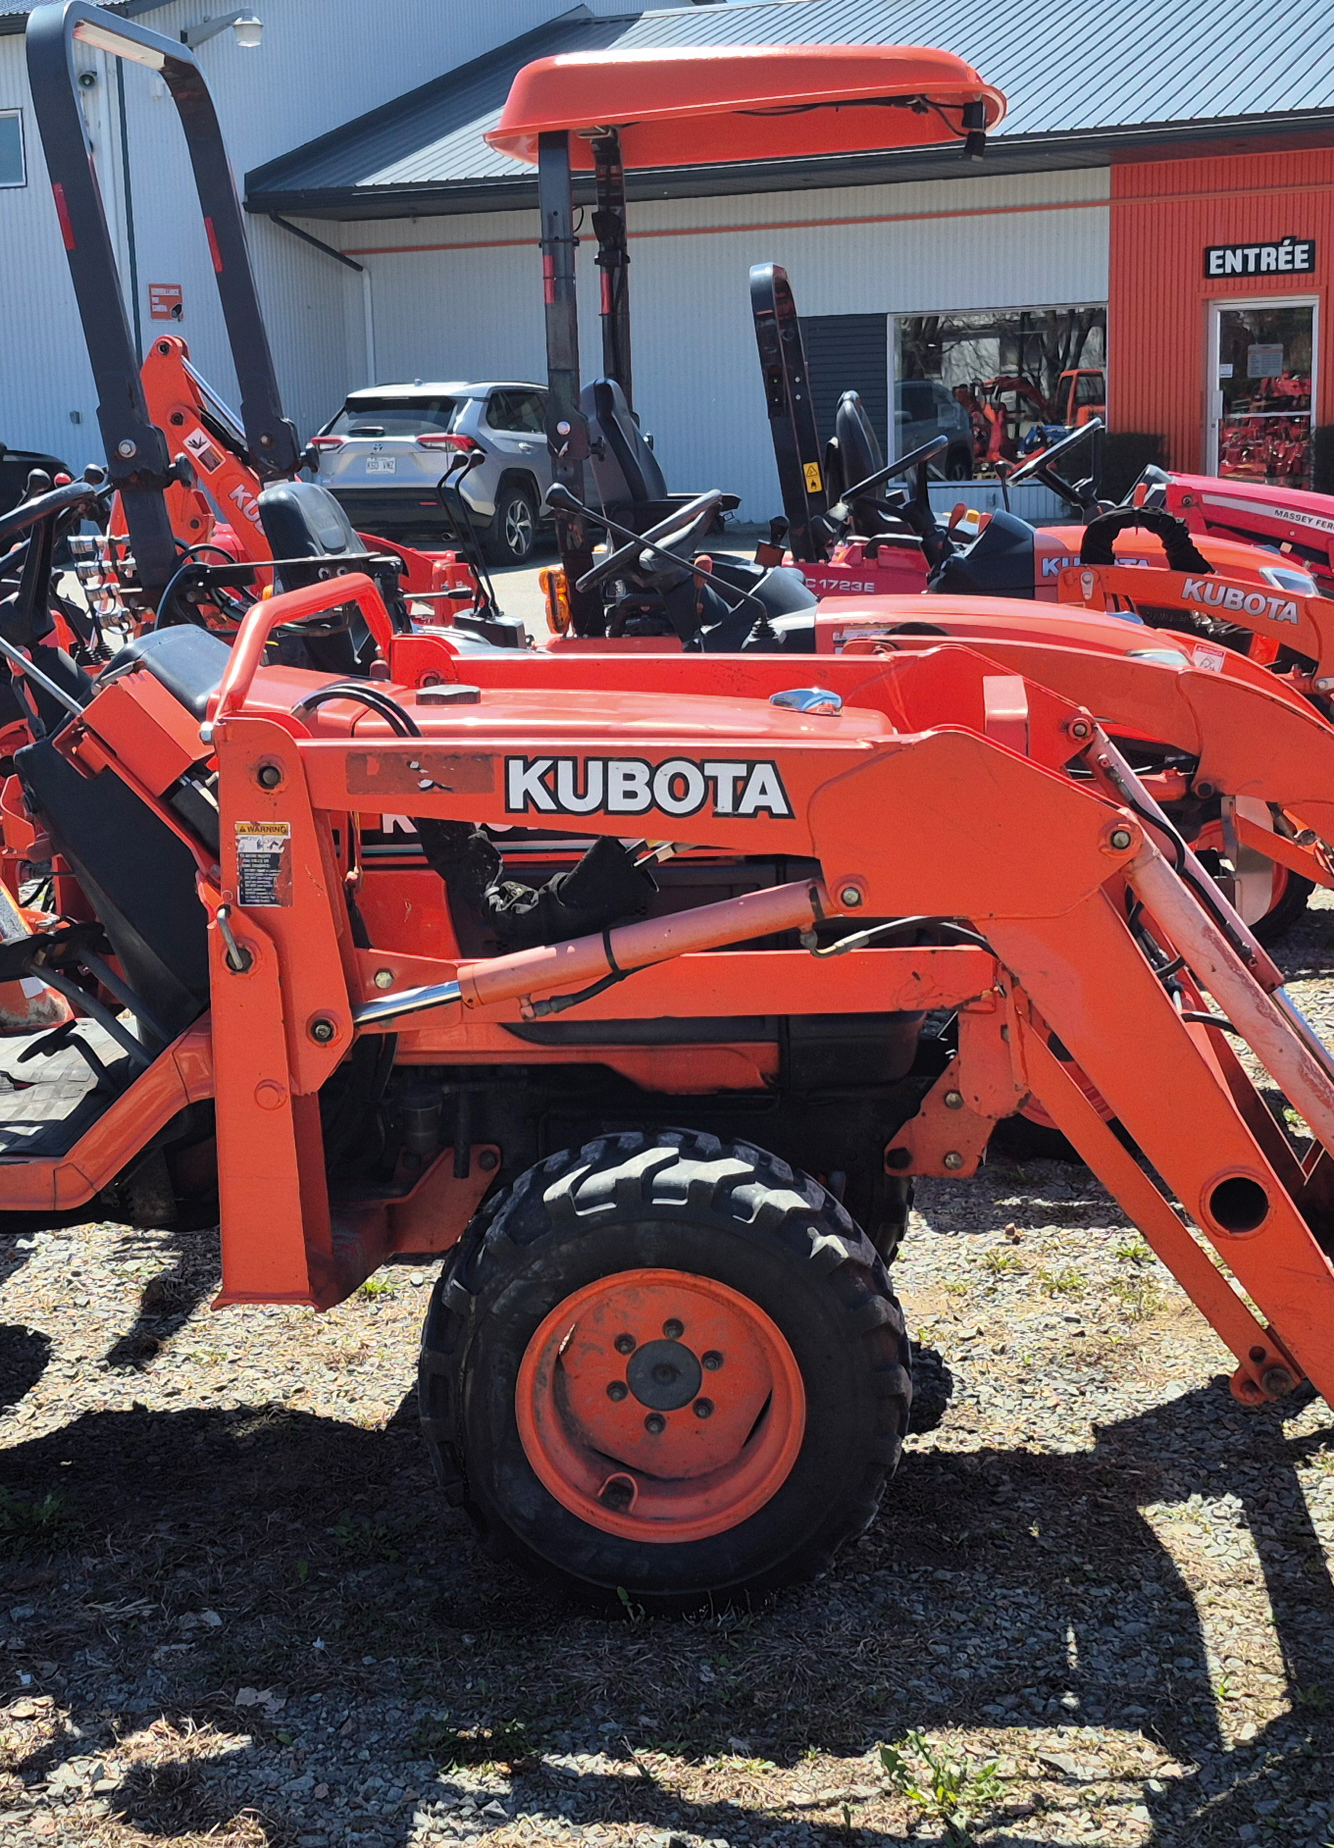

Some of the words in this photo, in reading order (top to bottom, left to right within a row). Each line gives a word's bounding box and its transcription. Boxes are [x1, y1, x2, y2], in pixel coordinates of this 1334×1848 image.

[1209, 239, 1309, 275] ENTRÉE
[1274, 509, 1314, 525] MASSEY
[1181, 578, 1299, 625] KUBOTA
[507, 757, 791, 816] KUBOTA
[247, 825, 287, 834] WARNING
